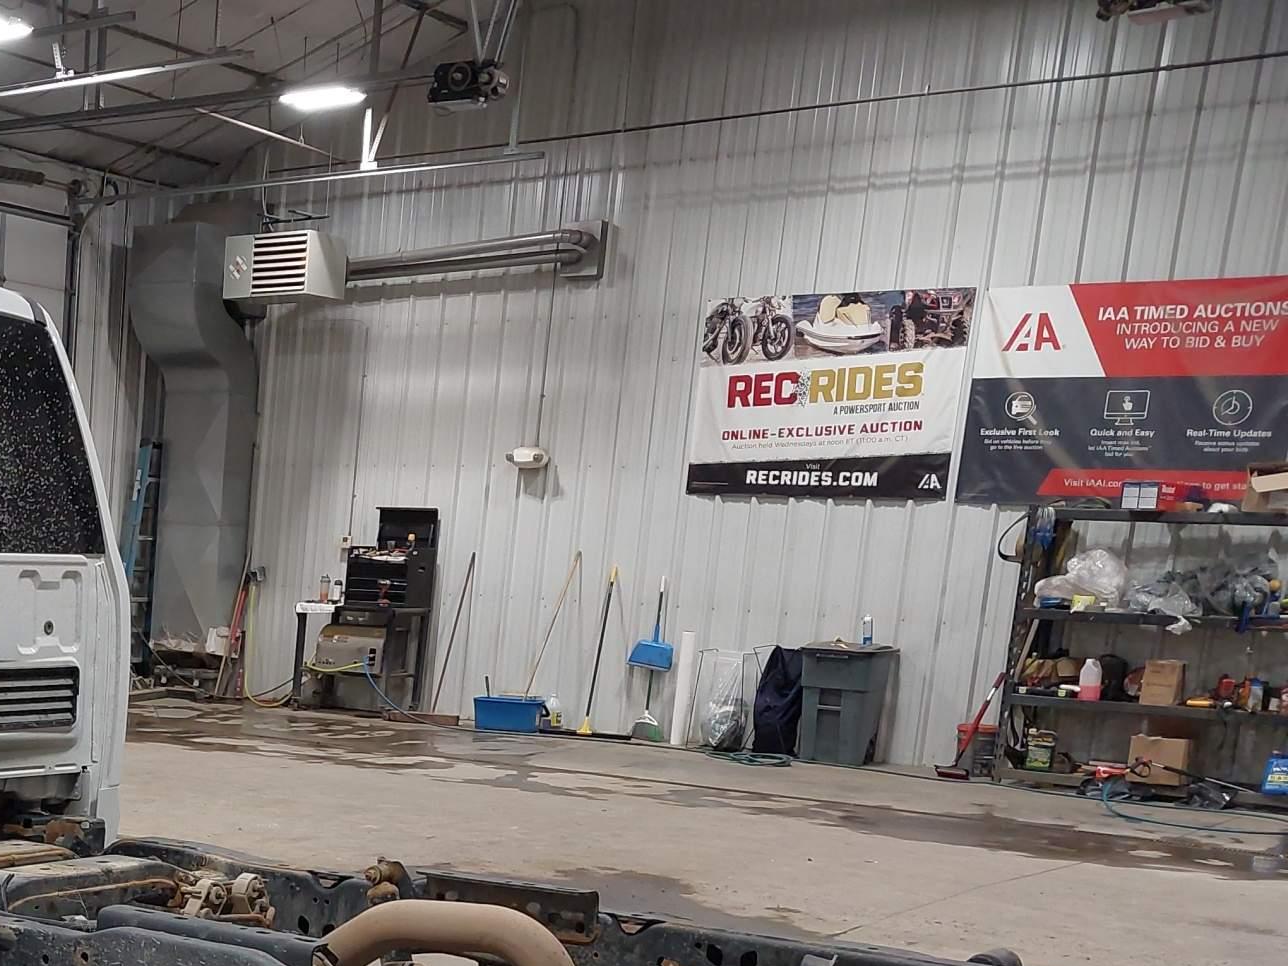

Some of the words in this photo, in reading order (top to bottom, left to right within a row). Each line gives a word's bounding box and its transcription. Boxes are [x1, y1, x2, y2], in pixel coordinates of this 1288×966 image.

[1097, 305, 1129, 321] IAA
[1133, 304, 1189, 320] TIMED
[1193, 301, 1288, 319] AUCTIONS
[1116, 320, 1219, 335] INTRODUCING
[1223, 321, 1235, 332] A
[1239, 319, 1280, 332] NEW
[1124, 336, 1157, 350] WAY
[1161, 336, 1181, 349] TO
[1185, 335, 1211, 348] BID
[1214, 335, 1226, 348] &
[1231, 334, 1266, 348] BUY
[727, 371, 800, 409] REC
[808, 361, 925, 404] RIDES
[833, 405, 839, 416] A
[839, 402, 887, 416] POWERSPORT
[888, 400, 920, 412] AUCTION
[721, 423, 856, 441] ONLINE-EXCLUSIVE
[859, 420, 923, 435] AUCTION
[979, 427, 1017, 436] Exclusive
[1018, 427, 1038, 436] First
[1038, 428, 1061, 436] Look
[1089, 428, 1115, 437] Quick
[1116, 428, 1134, 437] and
[1134, 428, 1156, 438] Easy
[1186, 428, 1231, 437] Real-Time
[1233, 429, 1273, 439] Updates
[805, 462, 821, 471] Visit
[746, 470, 879, 487] RECRIDES.COM
[1064, 479, 1084, 488] Visit
[1202, 481, 1213, 490] to
[1213, 482, 1230, 492] get
